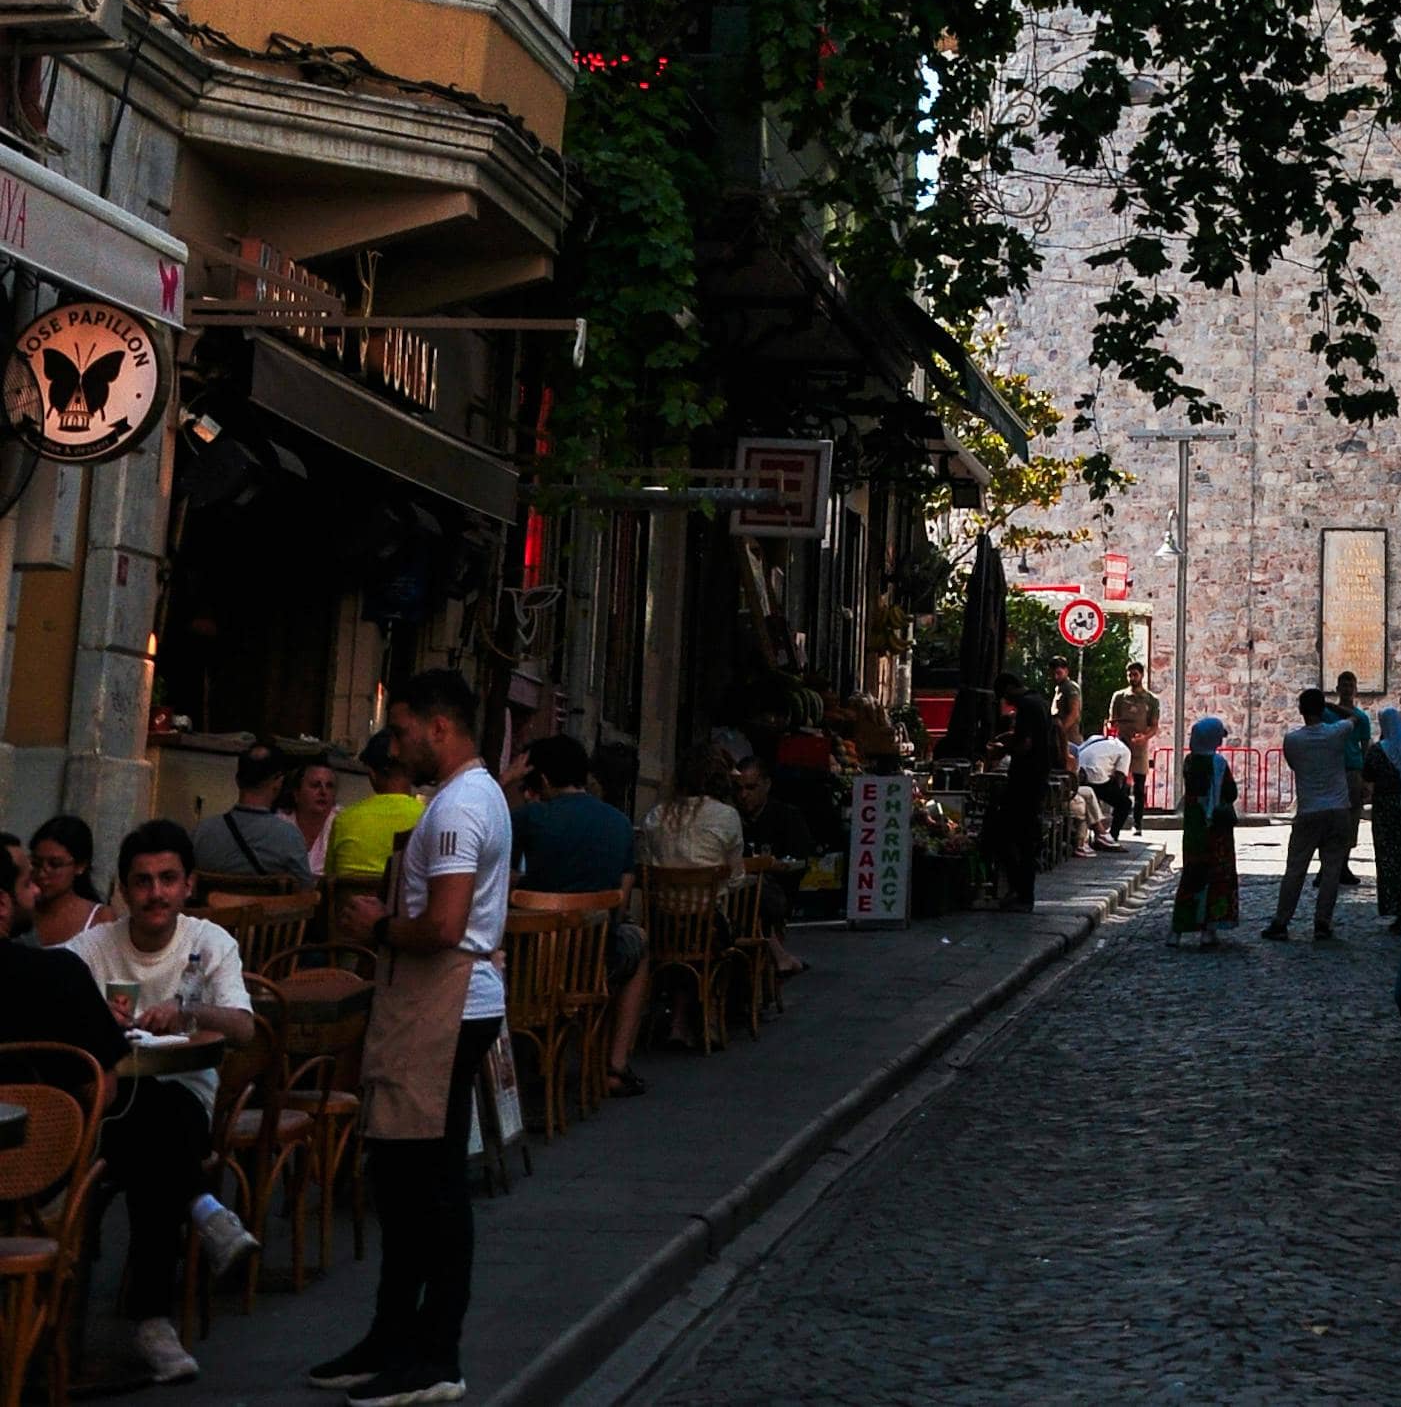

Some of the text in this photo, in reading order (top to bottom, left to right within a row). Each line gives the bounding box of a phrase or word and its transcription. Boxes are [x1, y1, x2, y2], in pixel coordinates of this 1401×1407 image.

[68, 310, 149, 368] PAPILLON
[857, 783, 901, 913] ECZANE PHARMACY
